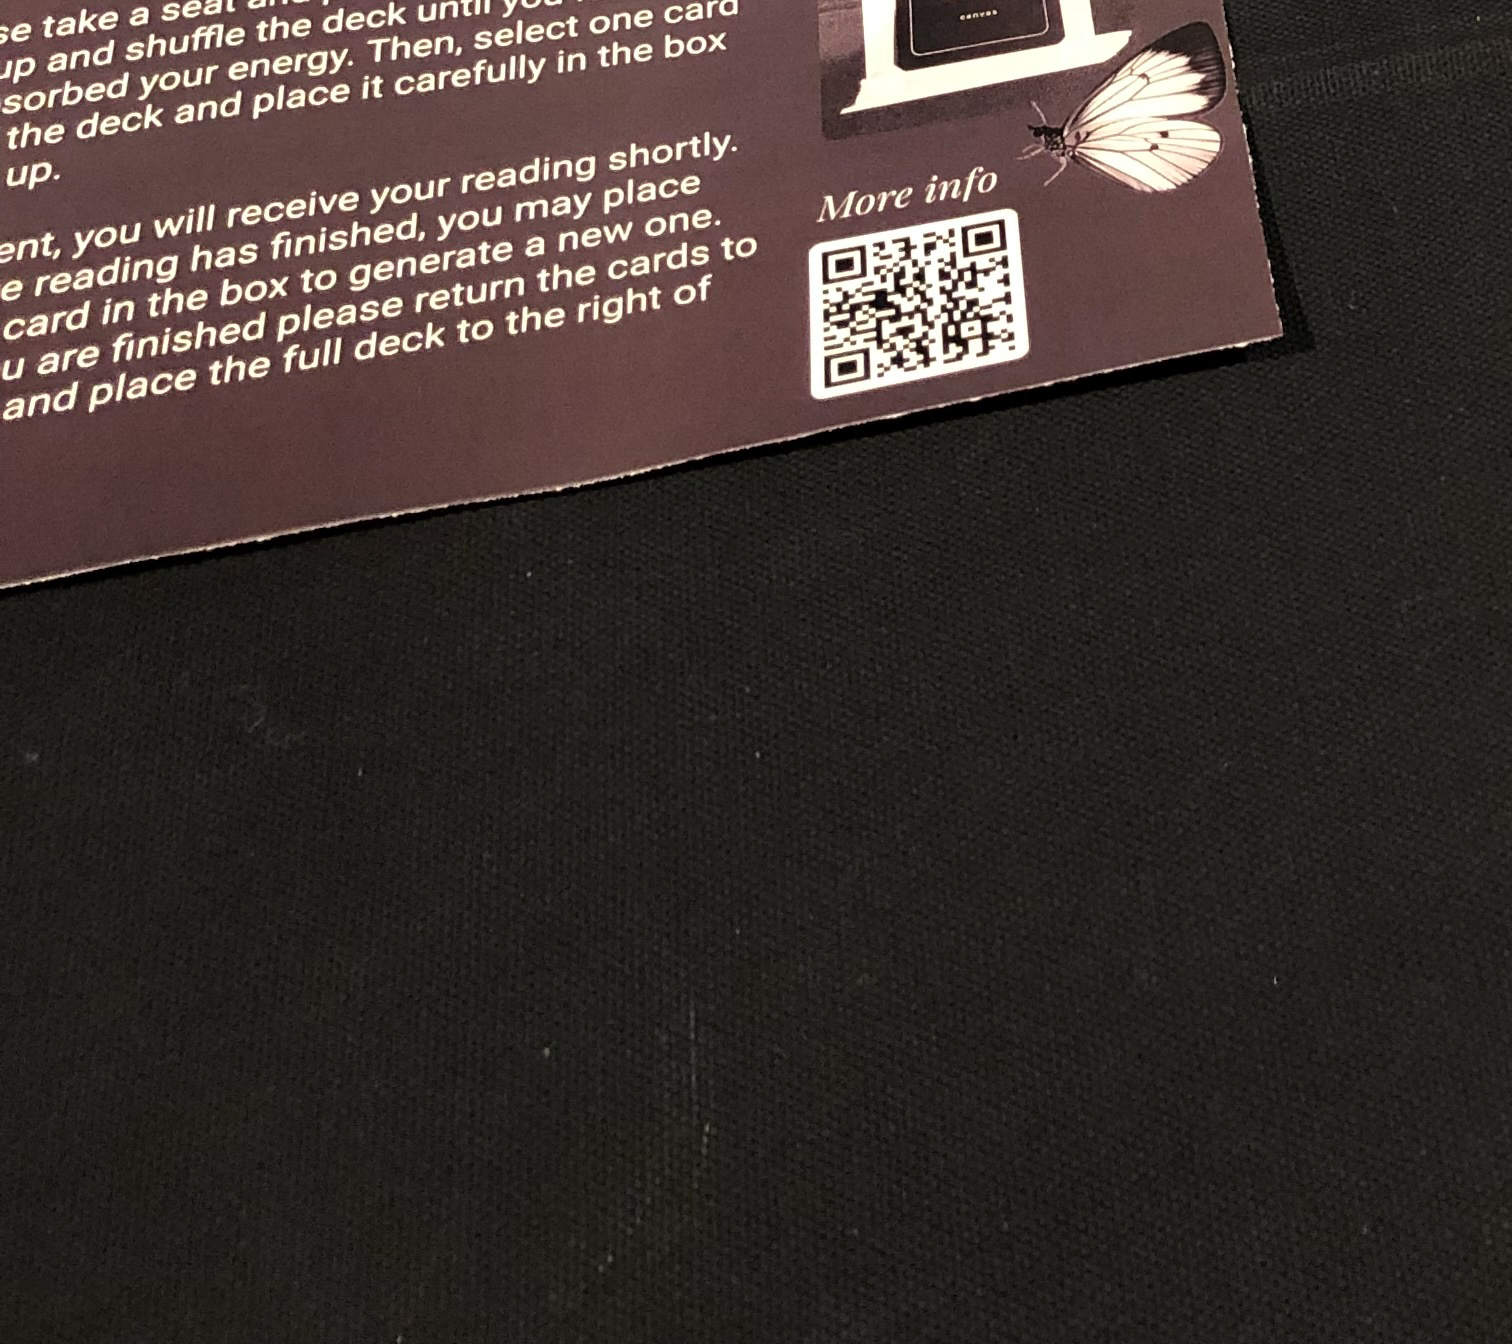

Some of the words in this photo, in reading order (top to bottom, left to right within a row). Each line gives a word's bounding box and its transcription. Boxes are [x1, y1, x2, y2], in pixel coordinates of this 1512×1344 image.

[42, 8, 119, 39] take
[129, 6, 150, 27] a
[46, 39, 115, 73] and
[125, 23, 246, 61] shuffle
[255, 15, 312, 43] the
[322, 1, 407, 34] deck
[137, 64, 220, 101] your
[228, 48, 354, 81] energy.
[366, 35, 463, 63] Then,
[473, 15, 579, 50] select
[589, 9, 654, 35] one
[6, 122, 65, 151] the
[76, 103, 164, 139] deck
[174, 90, 243, 124] and
[252, 83, 351, 120] place
[362, 75, 384, 100] it
[394, 54, 547, 95] carefully
[557, 49, 587, 74] in
[596, 41, 653, 68] the
[664, 32, 727, 59] box
[6, 161, 61, 190] up.
[71, 222, 142, 259] you
[154, 203, 216, 239] will
[227, 190, 360, 229] receive
[369, 177, 452, 215] your
[461, 155, 596, 194] reading
[608, 131, 738, 171] shortly.
[816, 190, 914, 223] More
[924, 166, 998, 204] info
[0, 279, 24, 302] e
[34, 254, 179, 297] reading
[190, 243, 259, 272] has
[270, 212, 426, 260] finished,
[437, 205, 503, 242] you
[515, 192, 593, 223] may
[603, 175, 701, 215] place
[2, 299, 91, 341] card
[102, 297, 135, 325] in
[147, 287, 209, 318] the
[220, 276, 289, 307] box
[300, 268, 337, 294] to
[349, 241, 514, 292] generate
[524, 236, 545, 258] a
[558, 221, 633, 253] new
[644, 209, 721, 237] one.
[1, 357, 25, 381] u
[37, 345, 100, 375] are
[111, 311, 267, 363] finished
[276, 296, 404, 343] please
[415, 276, 525, 313] return
[536, 263, 596, 293] the
[607, 241, 710, 280] cards
[720, 237, 758, 261] to
[2, 380, 79, 421] and
[88, 369, 197, 413] place
[208, 355, 271, 386] the
[282, 337, 342, 373] full
[354, 321, 446, 361] deck
[456, 319, 494, 343] to
[505, 305, 566, 335] the
[577, 286, 662, 324] right
[673, 273, 713, 305] of
